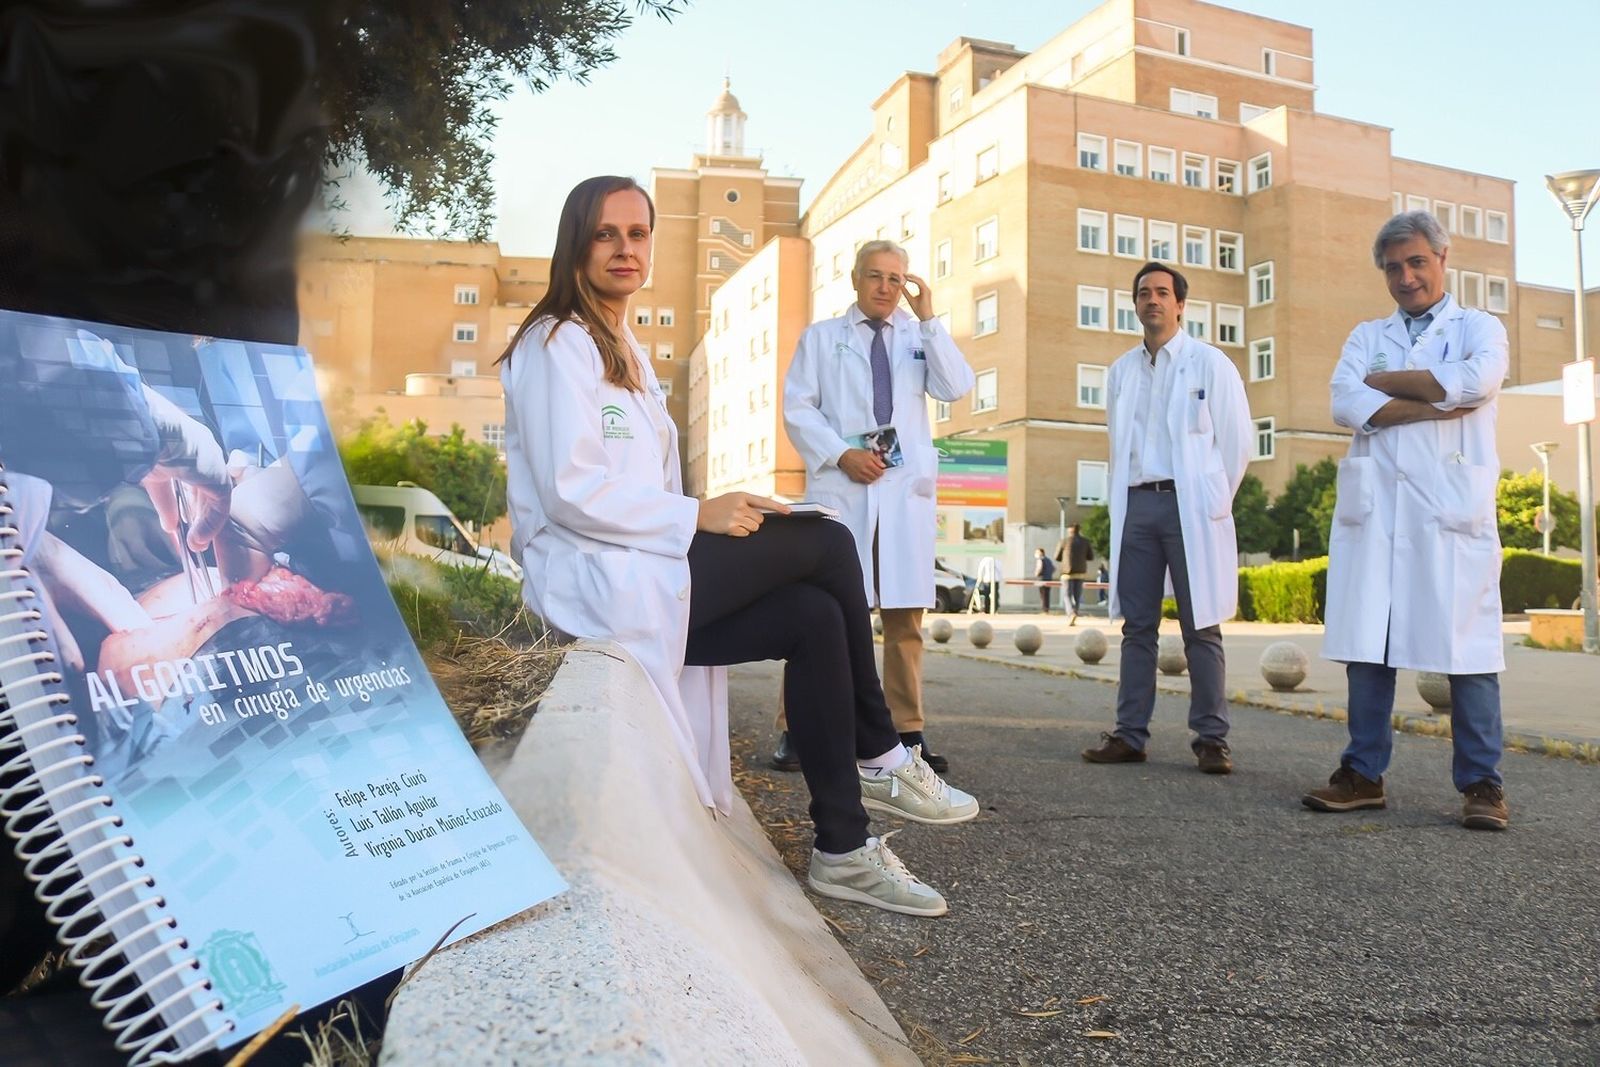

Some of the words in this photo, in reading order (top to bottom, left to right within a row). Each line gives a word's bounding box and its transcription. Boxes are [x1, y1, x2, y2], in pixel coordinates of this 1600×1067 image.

[86, 642, 304, 712] ALGORITMOS
[200, 704, 227, 725] en
[234, 681, 301, 720] cirugía
[305, 675, 331, 703] de
[335, 661, 412, 702] urgencias
[334, 788, 368, 808] Felipe
[367, 778, 401, 799] Pareja
[400, 769, 428, 788] Ciuró
[323, 808, 359, 858] Autores:
[349, 814, 374, 833] Luis
[372, 805, 406, 825] Tallón
[404, 795, 439, 818] Aguilar
[364, 833, 406, 859] Virginia
[404, 823, 438, 844] Durán
[435, 800, 503, 833] Muñoz-Cruzado
[408, 875, 417, 884] por
